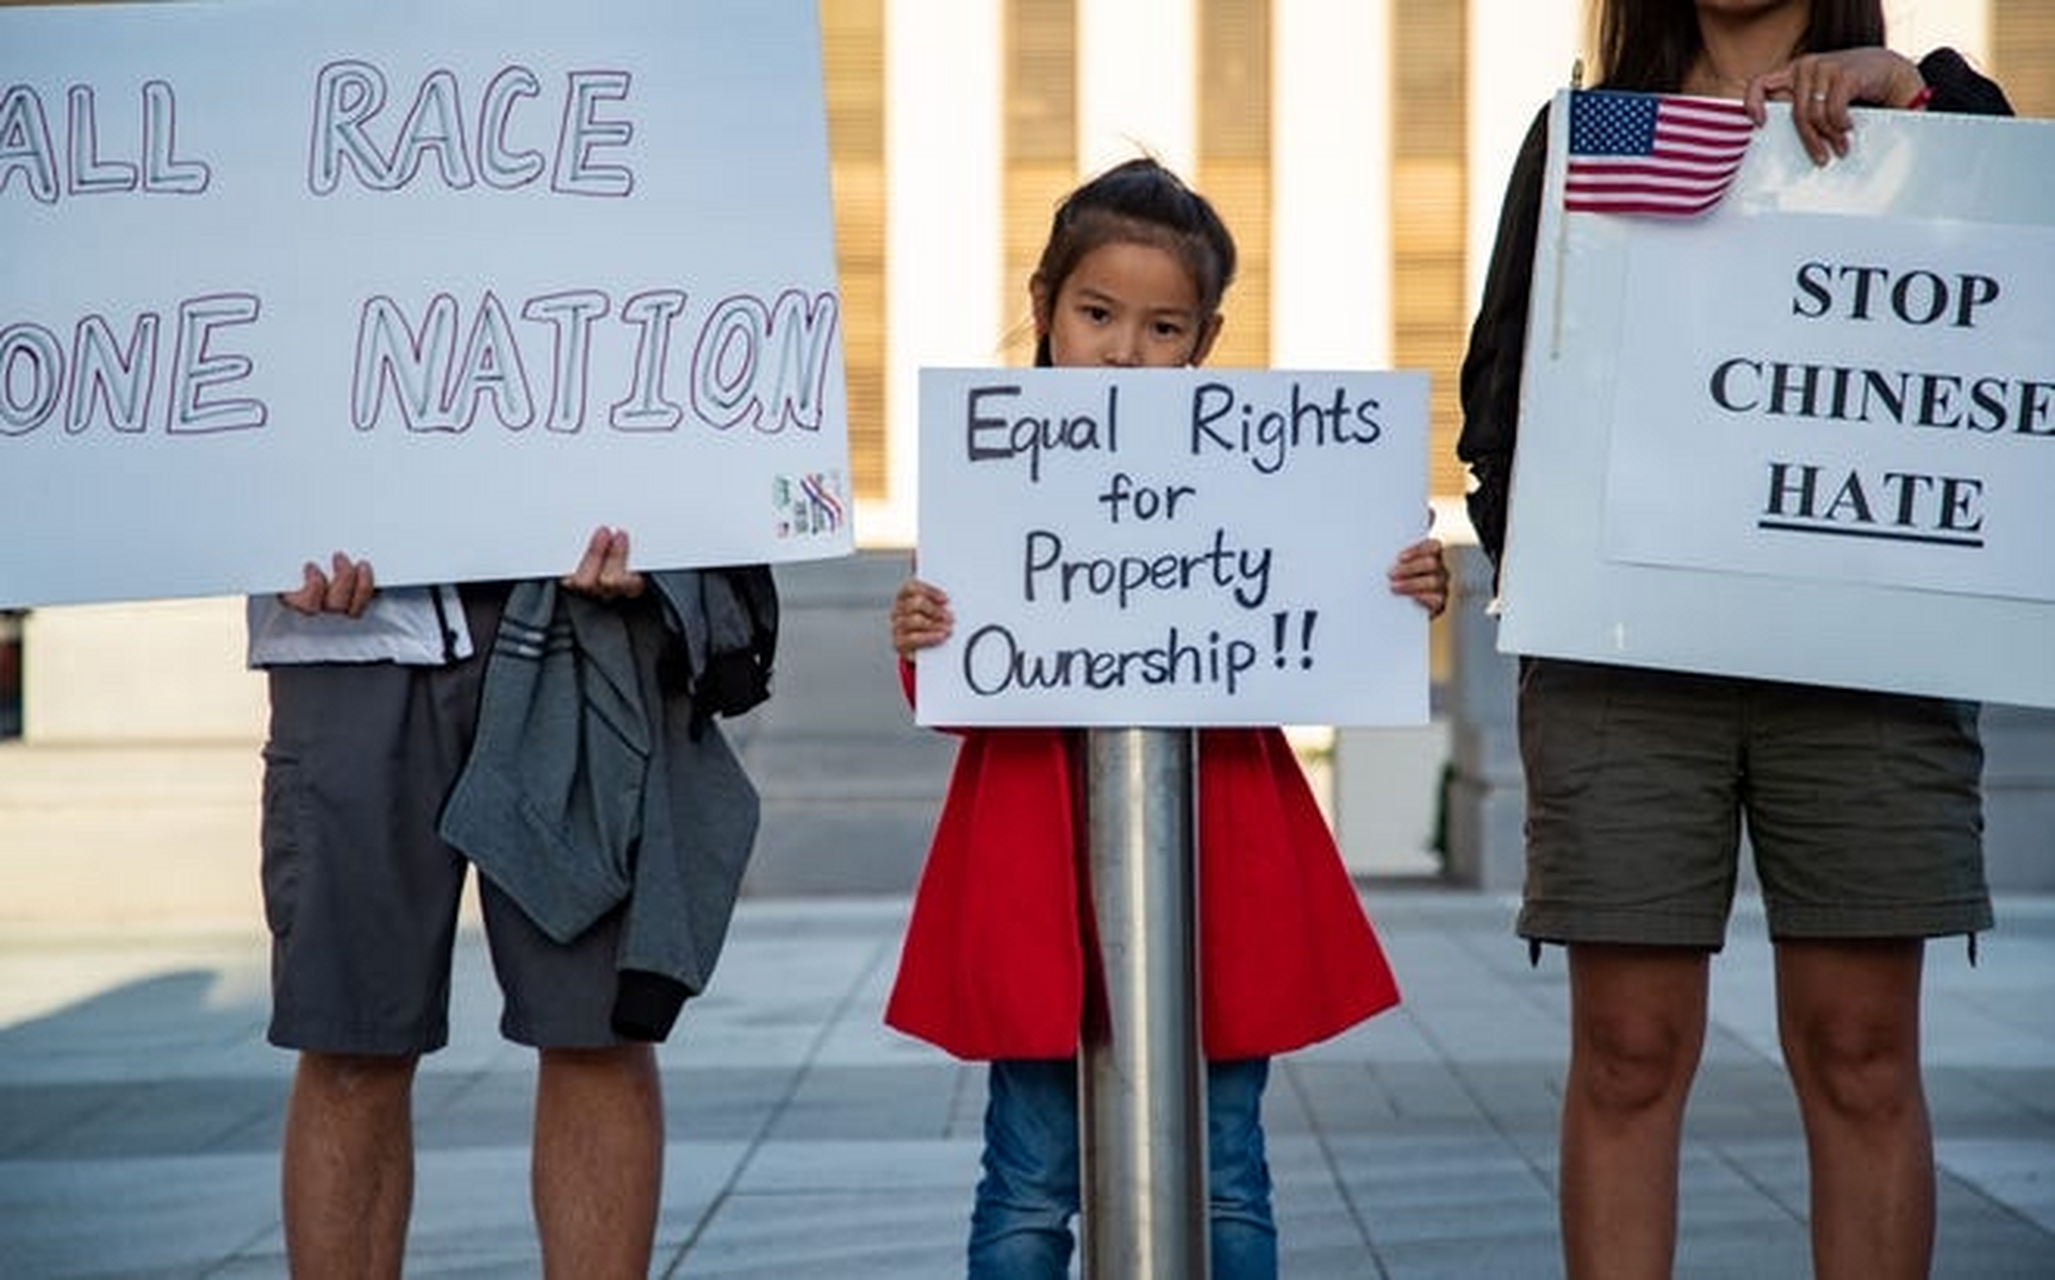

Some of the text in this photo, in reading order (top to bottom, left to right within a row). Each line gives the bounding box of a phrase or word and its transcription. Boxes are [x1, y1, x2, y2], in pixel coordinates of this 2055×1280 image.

[0, 60, 635, 203] ALL RACE
[1792, 262, 2000, 328] STOP
[0, 288, 839, 438] ONE NATION
[1709, 357, 2055, 438] CHINESE
[966, 382, 1381, 482] Equal Rights
[1098, 472, 1197, 524] for
[1764, 463, 1984, 534] HATE
[1023, 528, 1272, 610] Property
